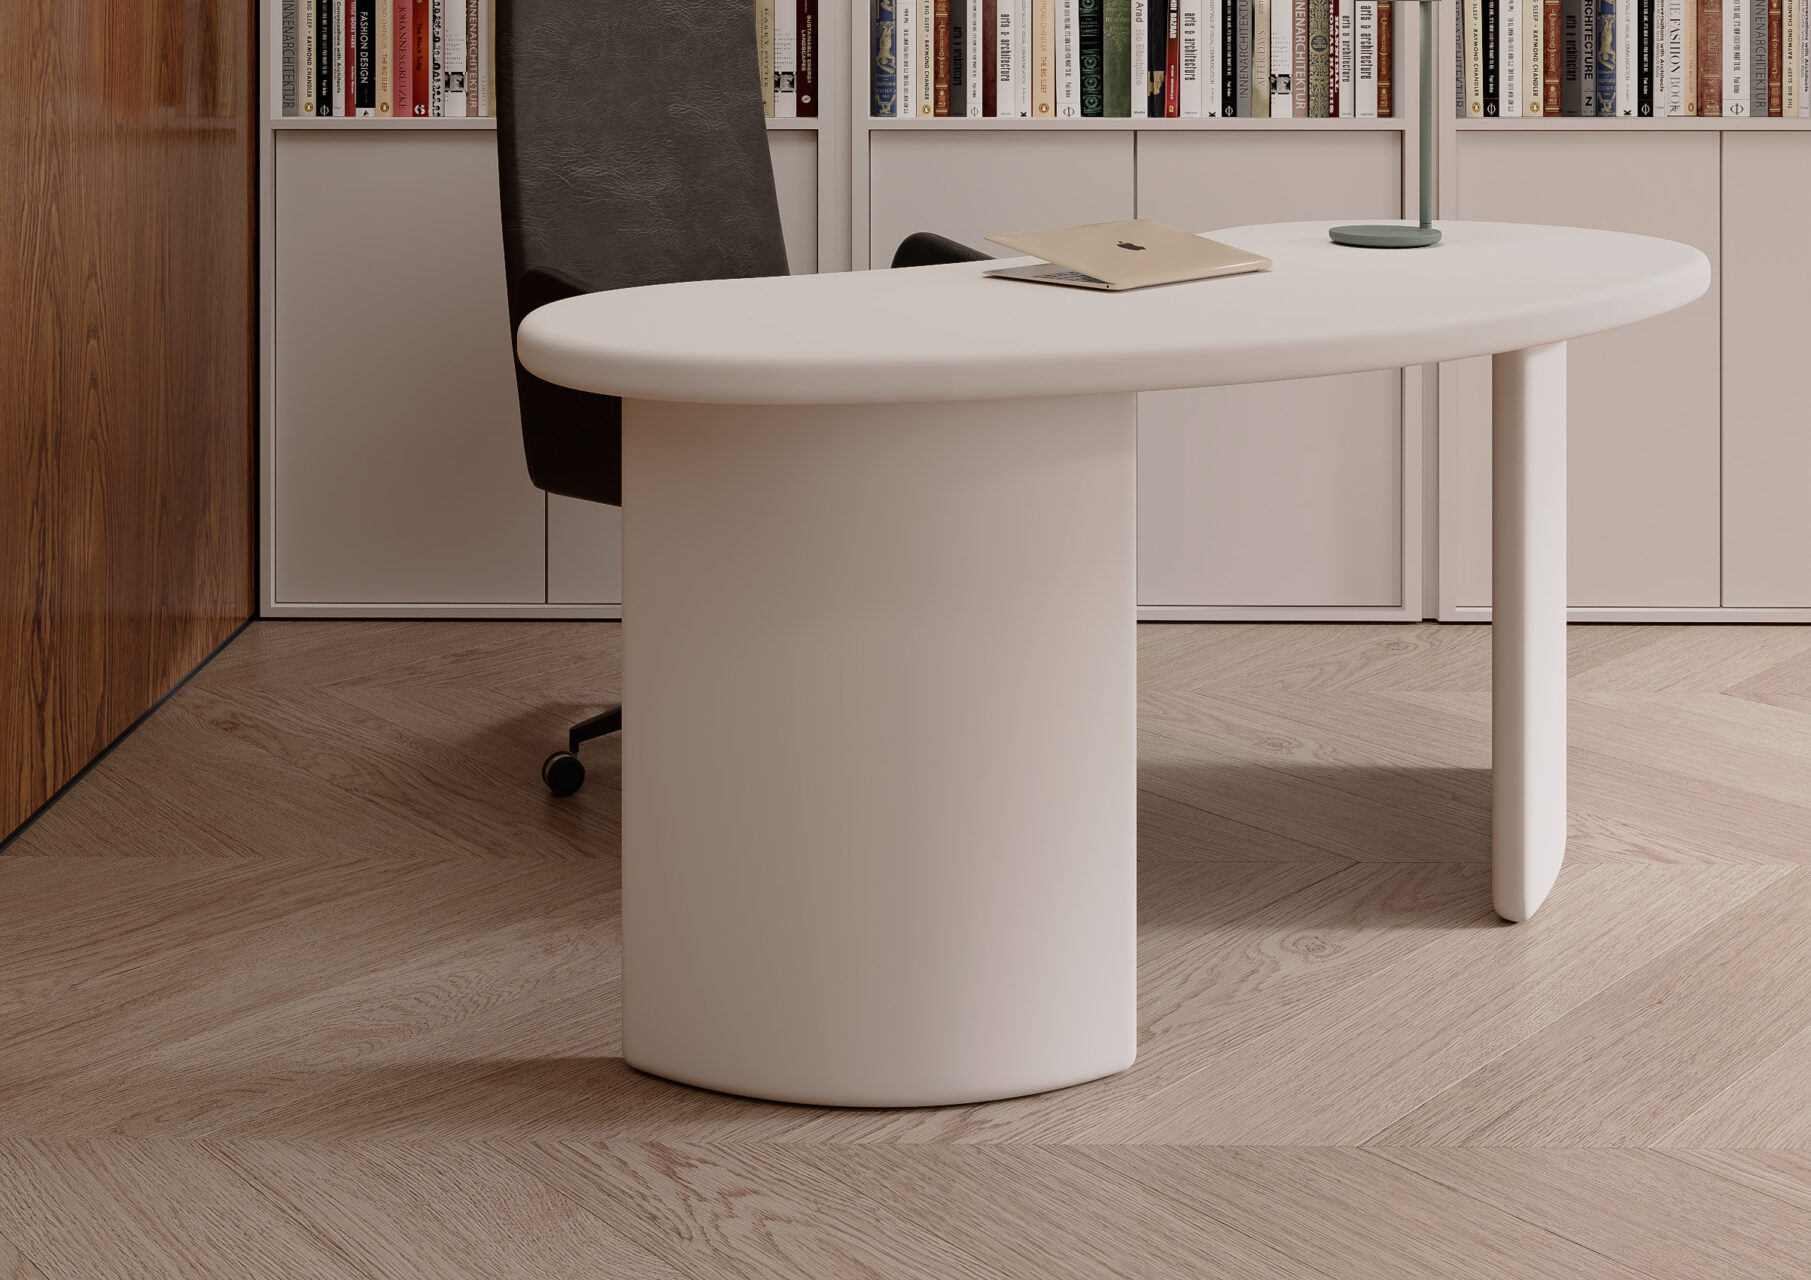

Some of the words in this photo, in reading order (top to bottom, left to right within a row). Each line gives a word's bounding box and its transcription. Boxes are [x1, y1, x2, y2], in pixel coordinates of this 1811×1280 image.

[360, 11, 368, 49] FASHION
[1001, 14, 1011, 27] arts
[1136, 2, 1144, 22] Arad
[1185, 13, 1197, 26] arts
[1342, 15, 1351, 28] arts
[1361, 5, 1373, 20] arts
[398, 6, 406, 59] JOHANNES
[1670, 18, 1681, 73] FASHION
[282, 0, 295, 108] INNENARCHITEKTUR
[360, 52, 368, 84] DESIGN
[1001, 39, 1011, 82] architecture
[1185, 38, 1197, 81] architecture
[1342, 40, 1351, 82] architecture
[1361, 33, 1373, 79] architecture
